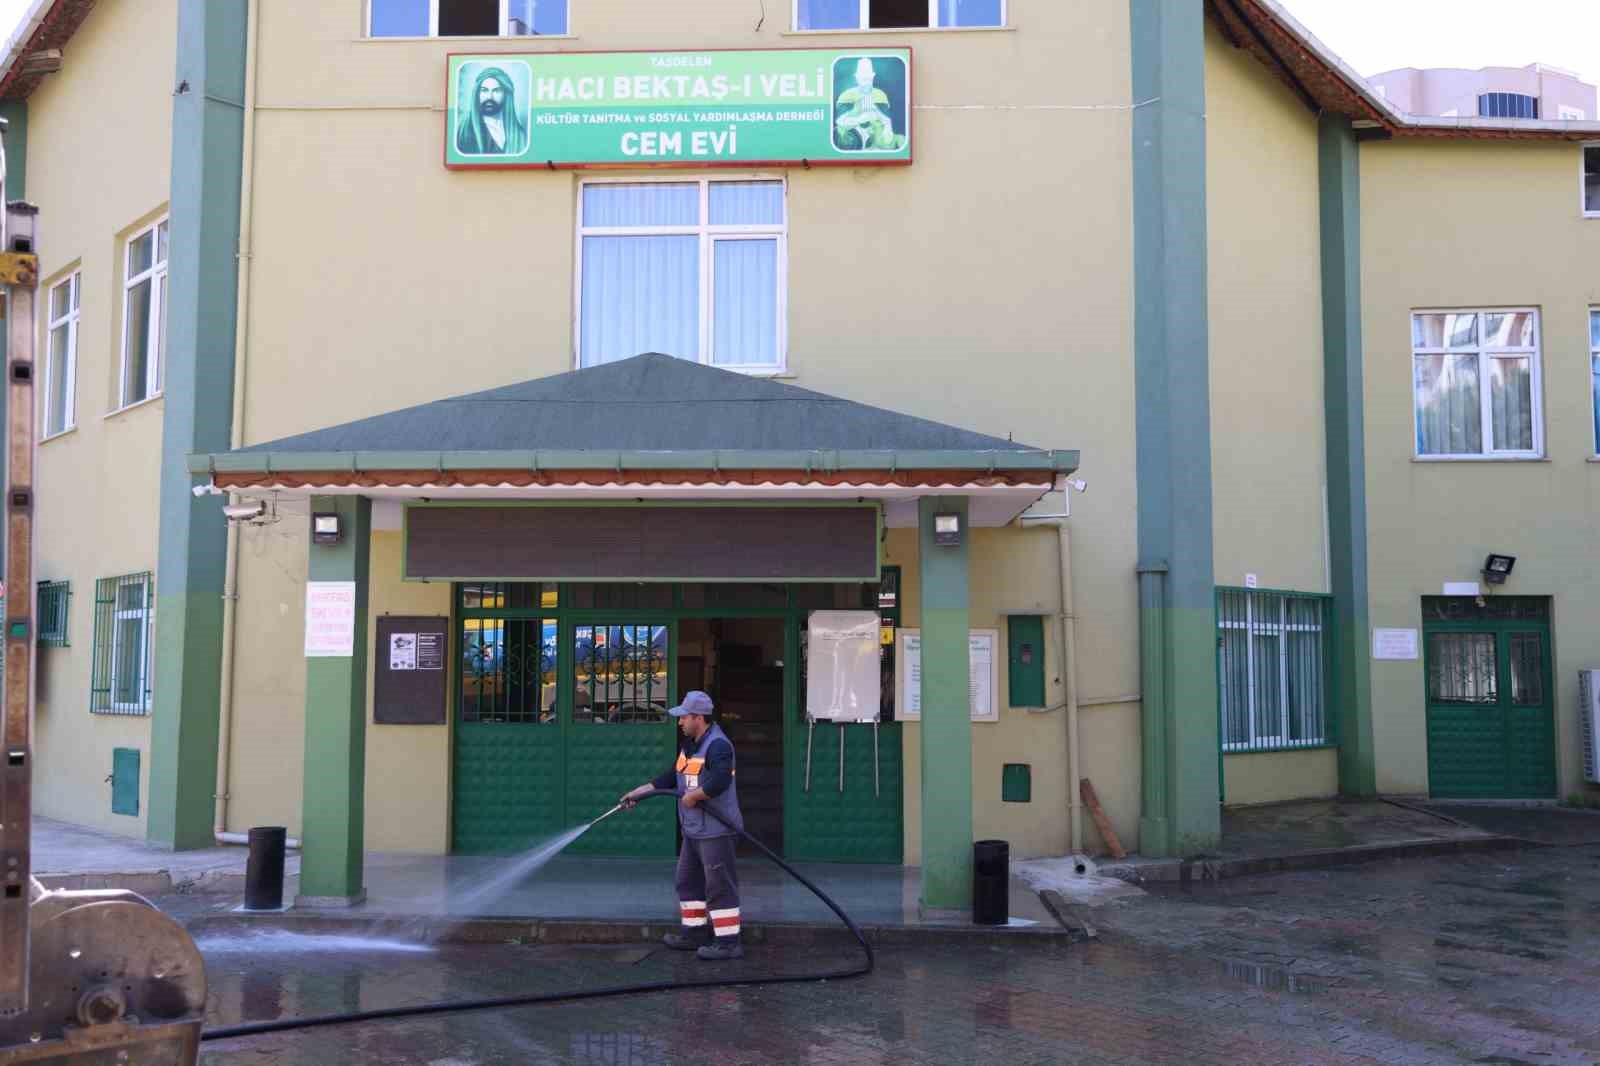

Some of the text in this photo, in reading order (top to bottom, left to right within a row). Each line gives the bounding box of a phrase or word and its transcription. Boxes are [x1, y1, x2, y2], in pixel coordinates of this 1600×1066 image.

[537, 65, 824, 101] HACI BEKTAŞ-I VELİ
[536, 108, 824, 125] KÜLTÜR TANITMA ve SOSYAL YARDIMLAŞMA DERNEĞİ
[620, 124, 736, 156] CEM EVİ
